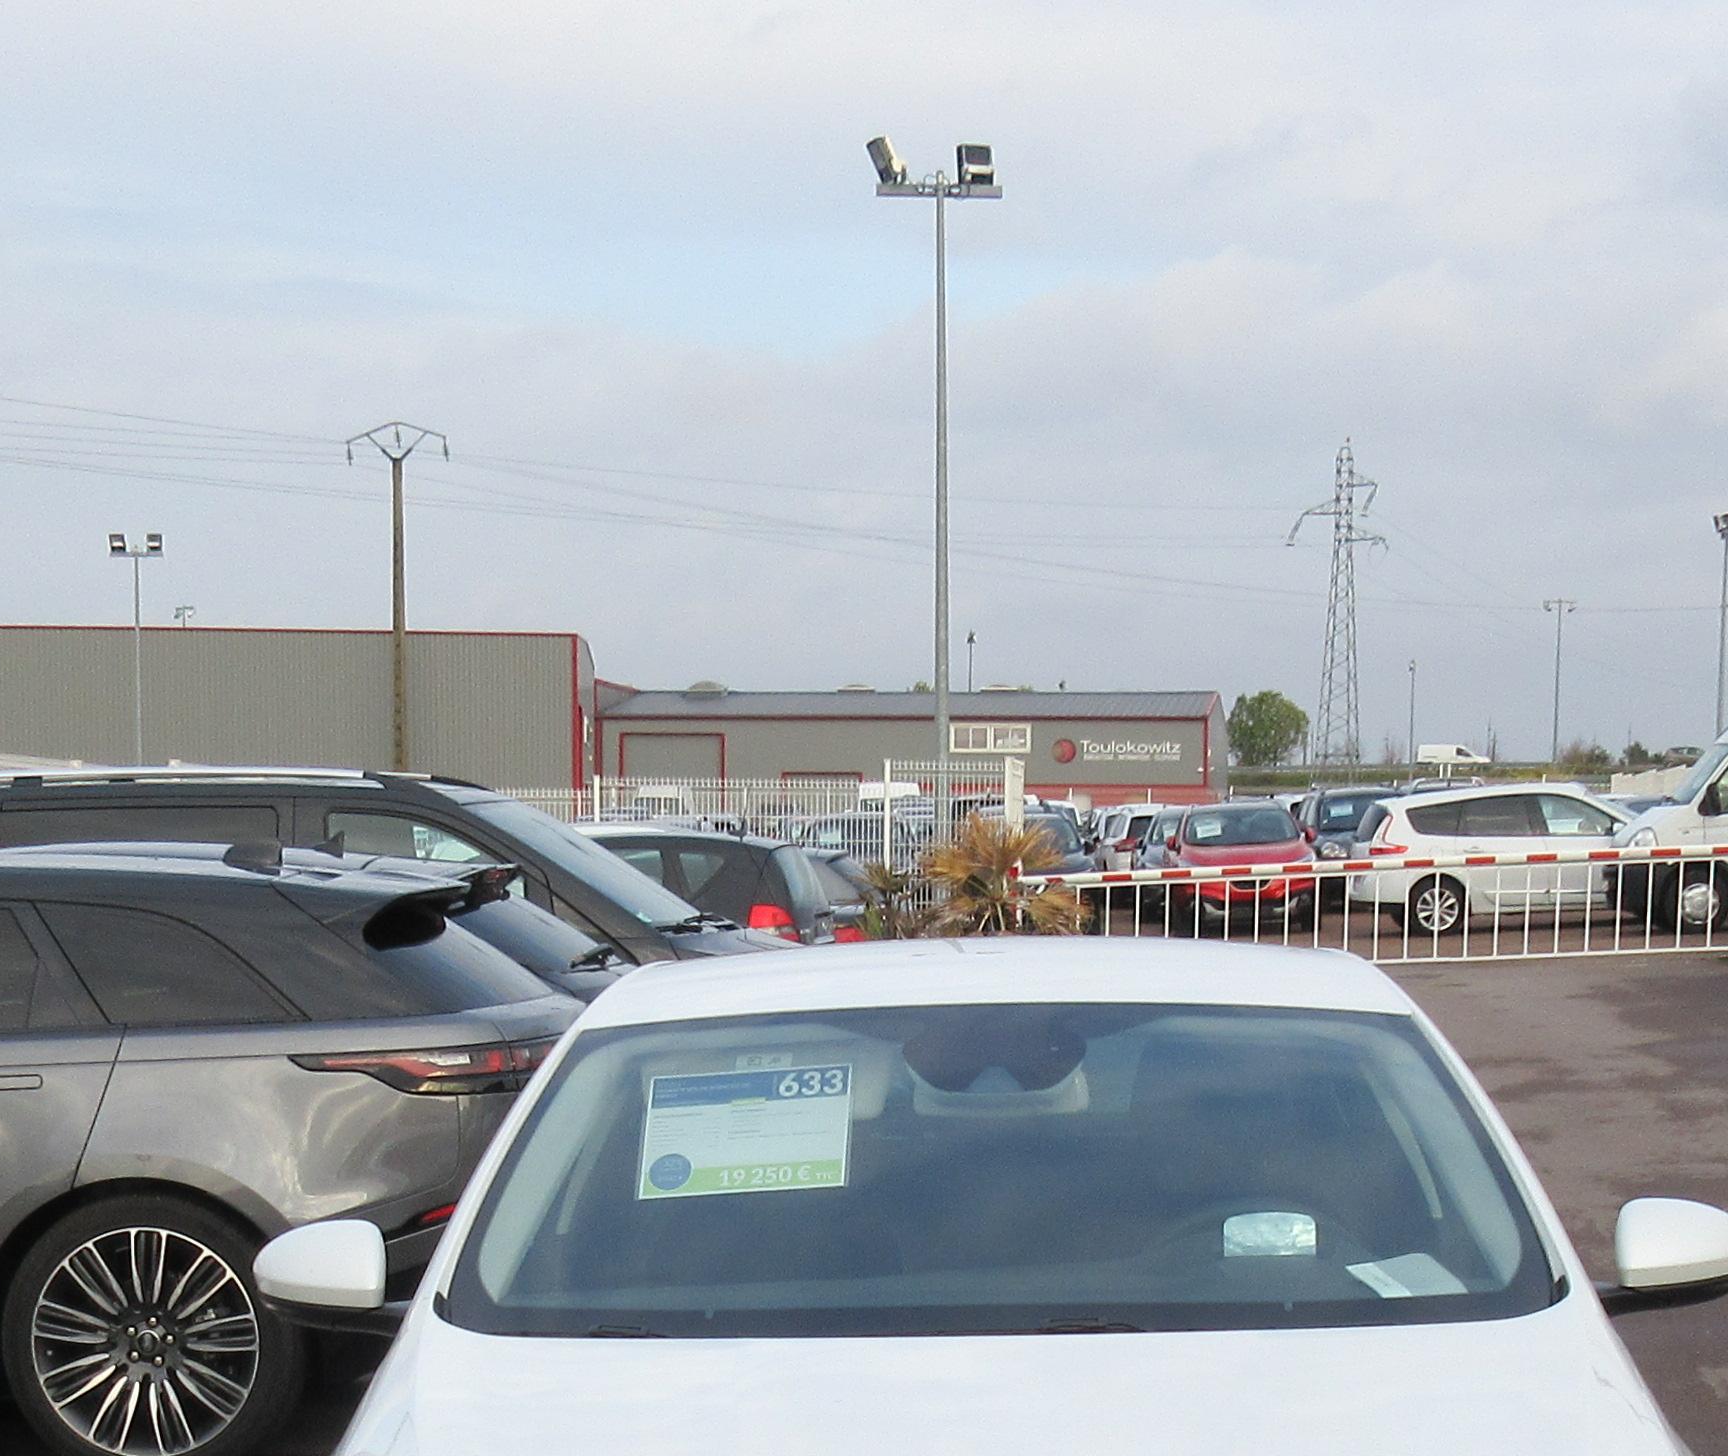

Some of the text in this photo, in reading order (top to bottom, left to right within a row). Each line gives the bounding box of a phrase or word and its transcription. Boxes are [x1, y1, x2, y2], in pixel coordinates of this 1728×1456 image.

[1080, 740, 1182, 754] Toulokowitz
[778, 1069, 844, 1097] 633
[719, 1169, 745, 1187] 19
[751, 1166, 792, 1184] 250
[797, 1165, 811, 1181] €
